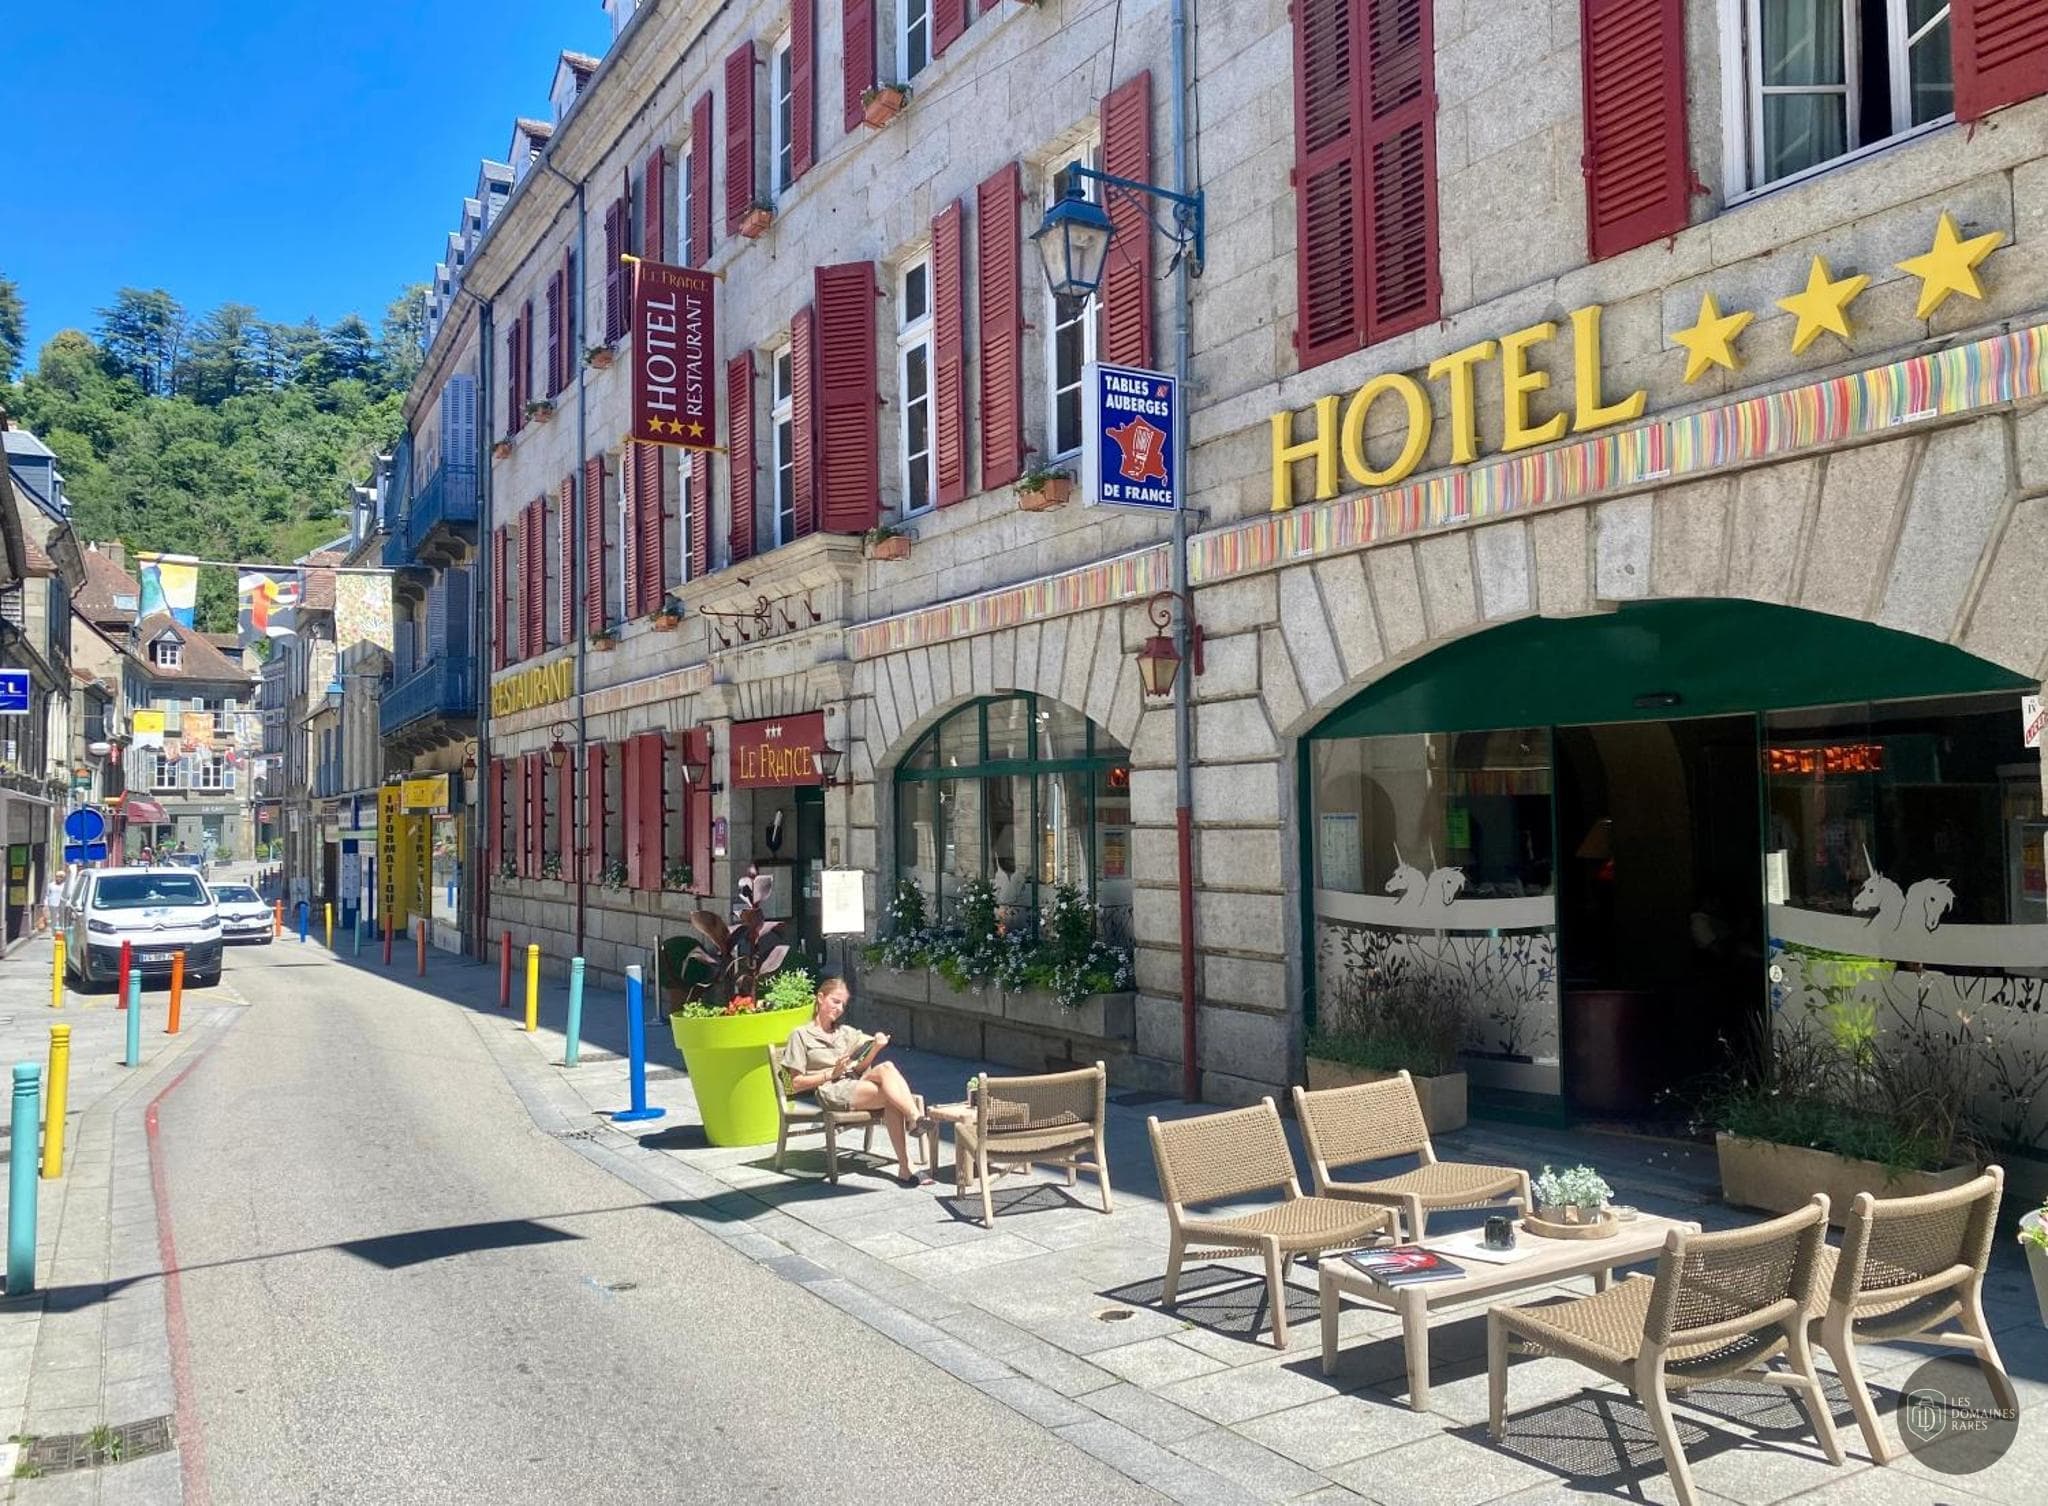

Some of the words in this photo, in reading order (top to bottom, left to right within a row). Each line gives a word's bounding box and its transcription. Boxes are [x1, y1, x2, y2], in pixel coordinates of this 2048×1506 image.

[662, 271, 709, 292] FRANCE
[646, 292, 677, 412] HOTEL
[686, 294, 702, 416] RESTAURANT
[1105, 375, 1149, 396] TABLES
[1105, 393, 1169, 416] AUBERGES
[1270, 304, 1648, 513] HOTEL
[1103, 483, 1121, 498] DE
[1125, 485, 1172, 503] FRANCE
[491, 657, 574, 717] RESTAURANT
[740, 745, 756, 779] LE
[760, 744, 812, 782] FRANCE
[384, 794, 396, 913] INFORMATIQUE
